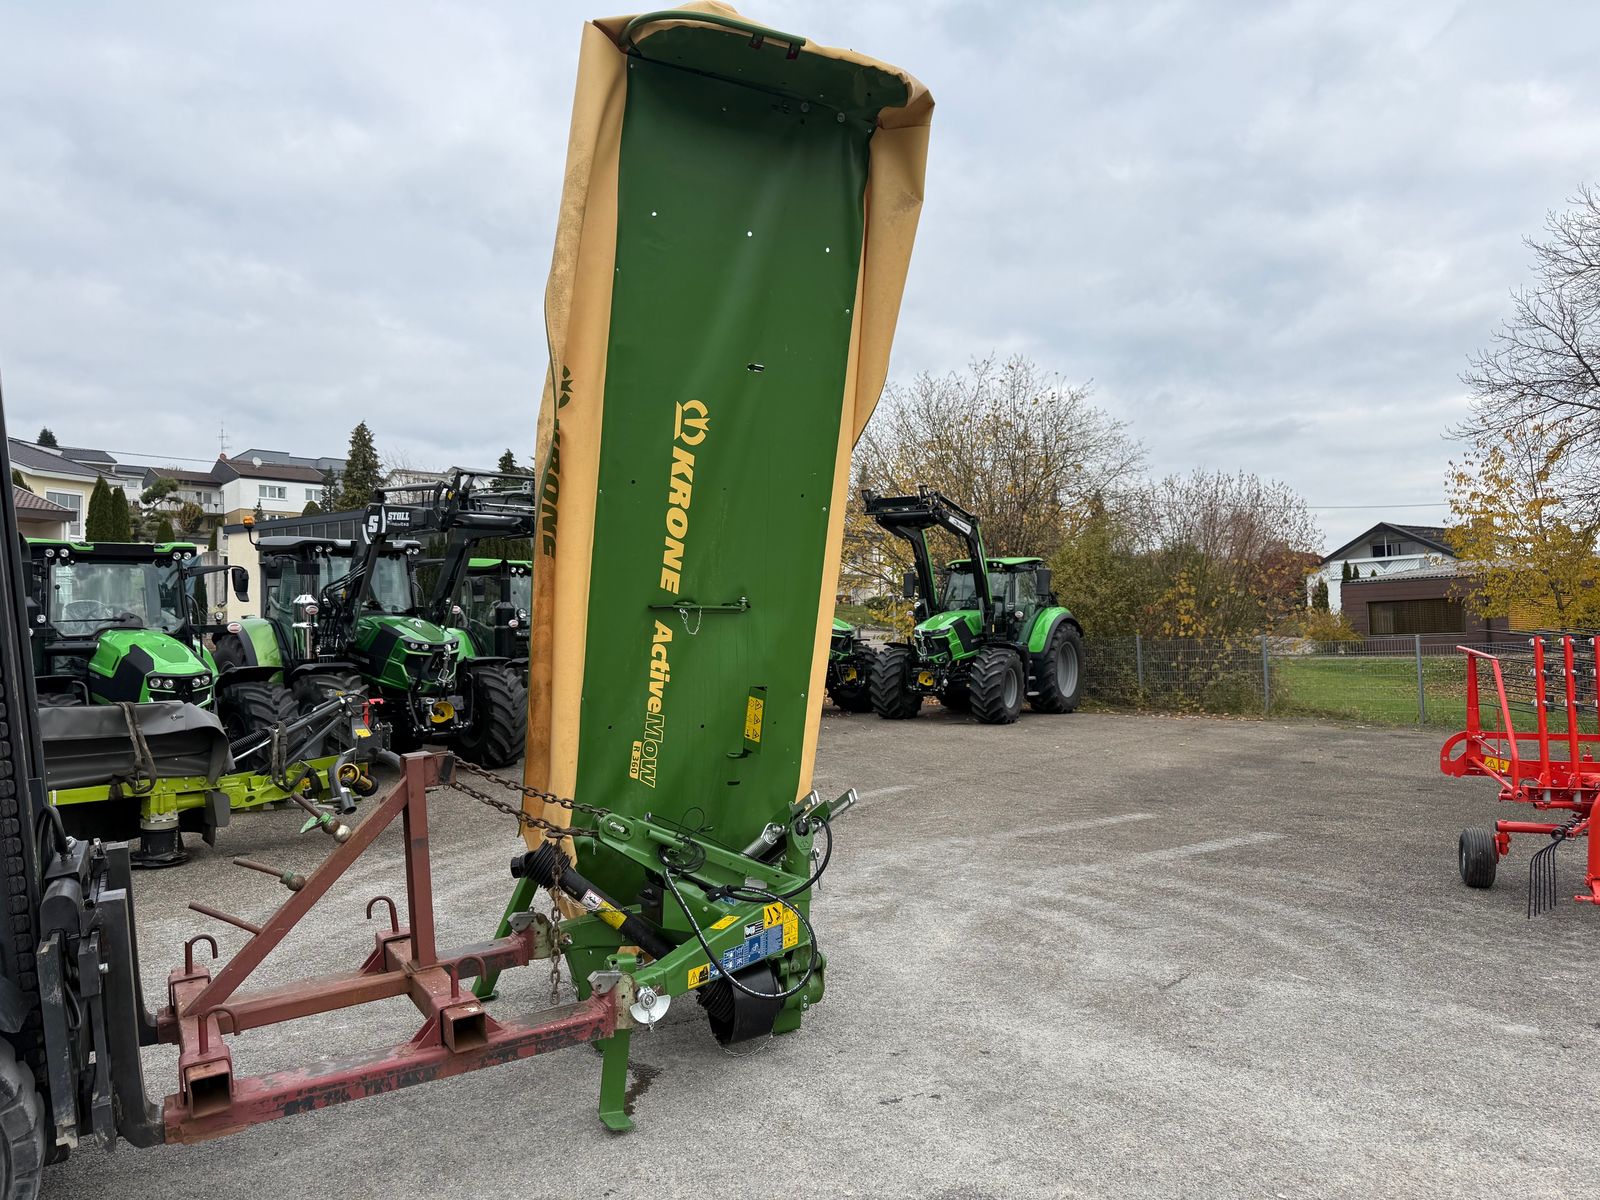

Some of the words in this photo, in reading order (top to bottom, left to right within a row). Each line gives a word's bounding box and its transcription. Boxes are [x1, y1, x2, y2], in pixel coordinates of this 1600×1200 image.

[387, 511, 410, 520] STOLL
[659, 445, 696, 595] KRONE
[631, 756, 639, 773] 360
